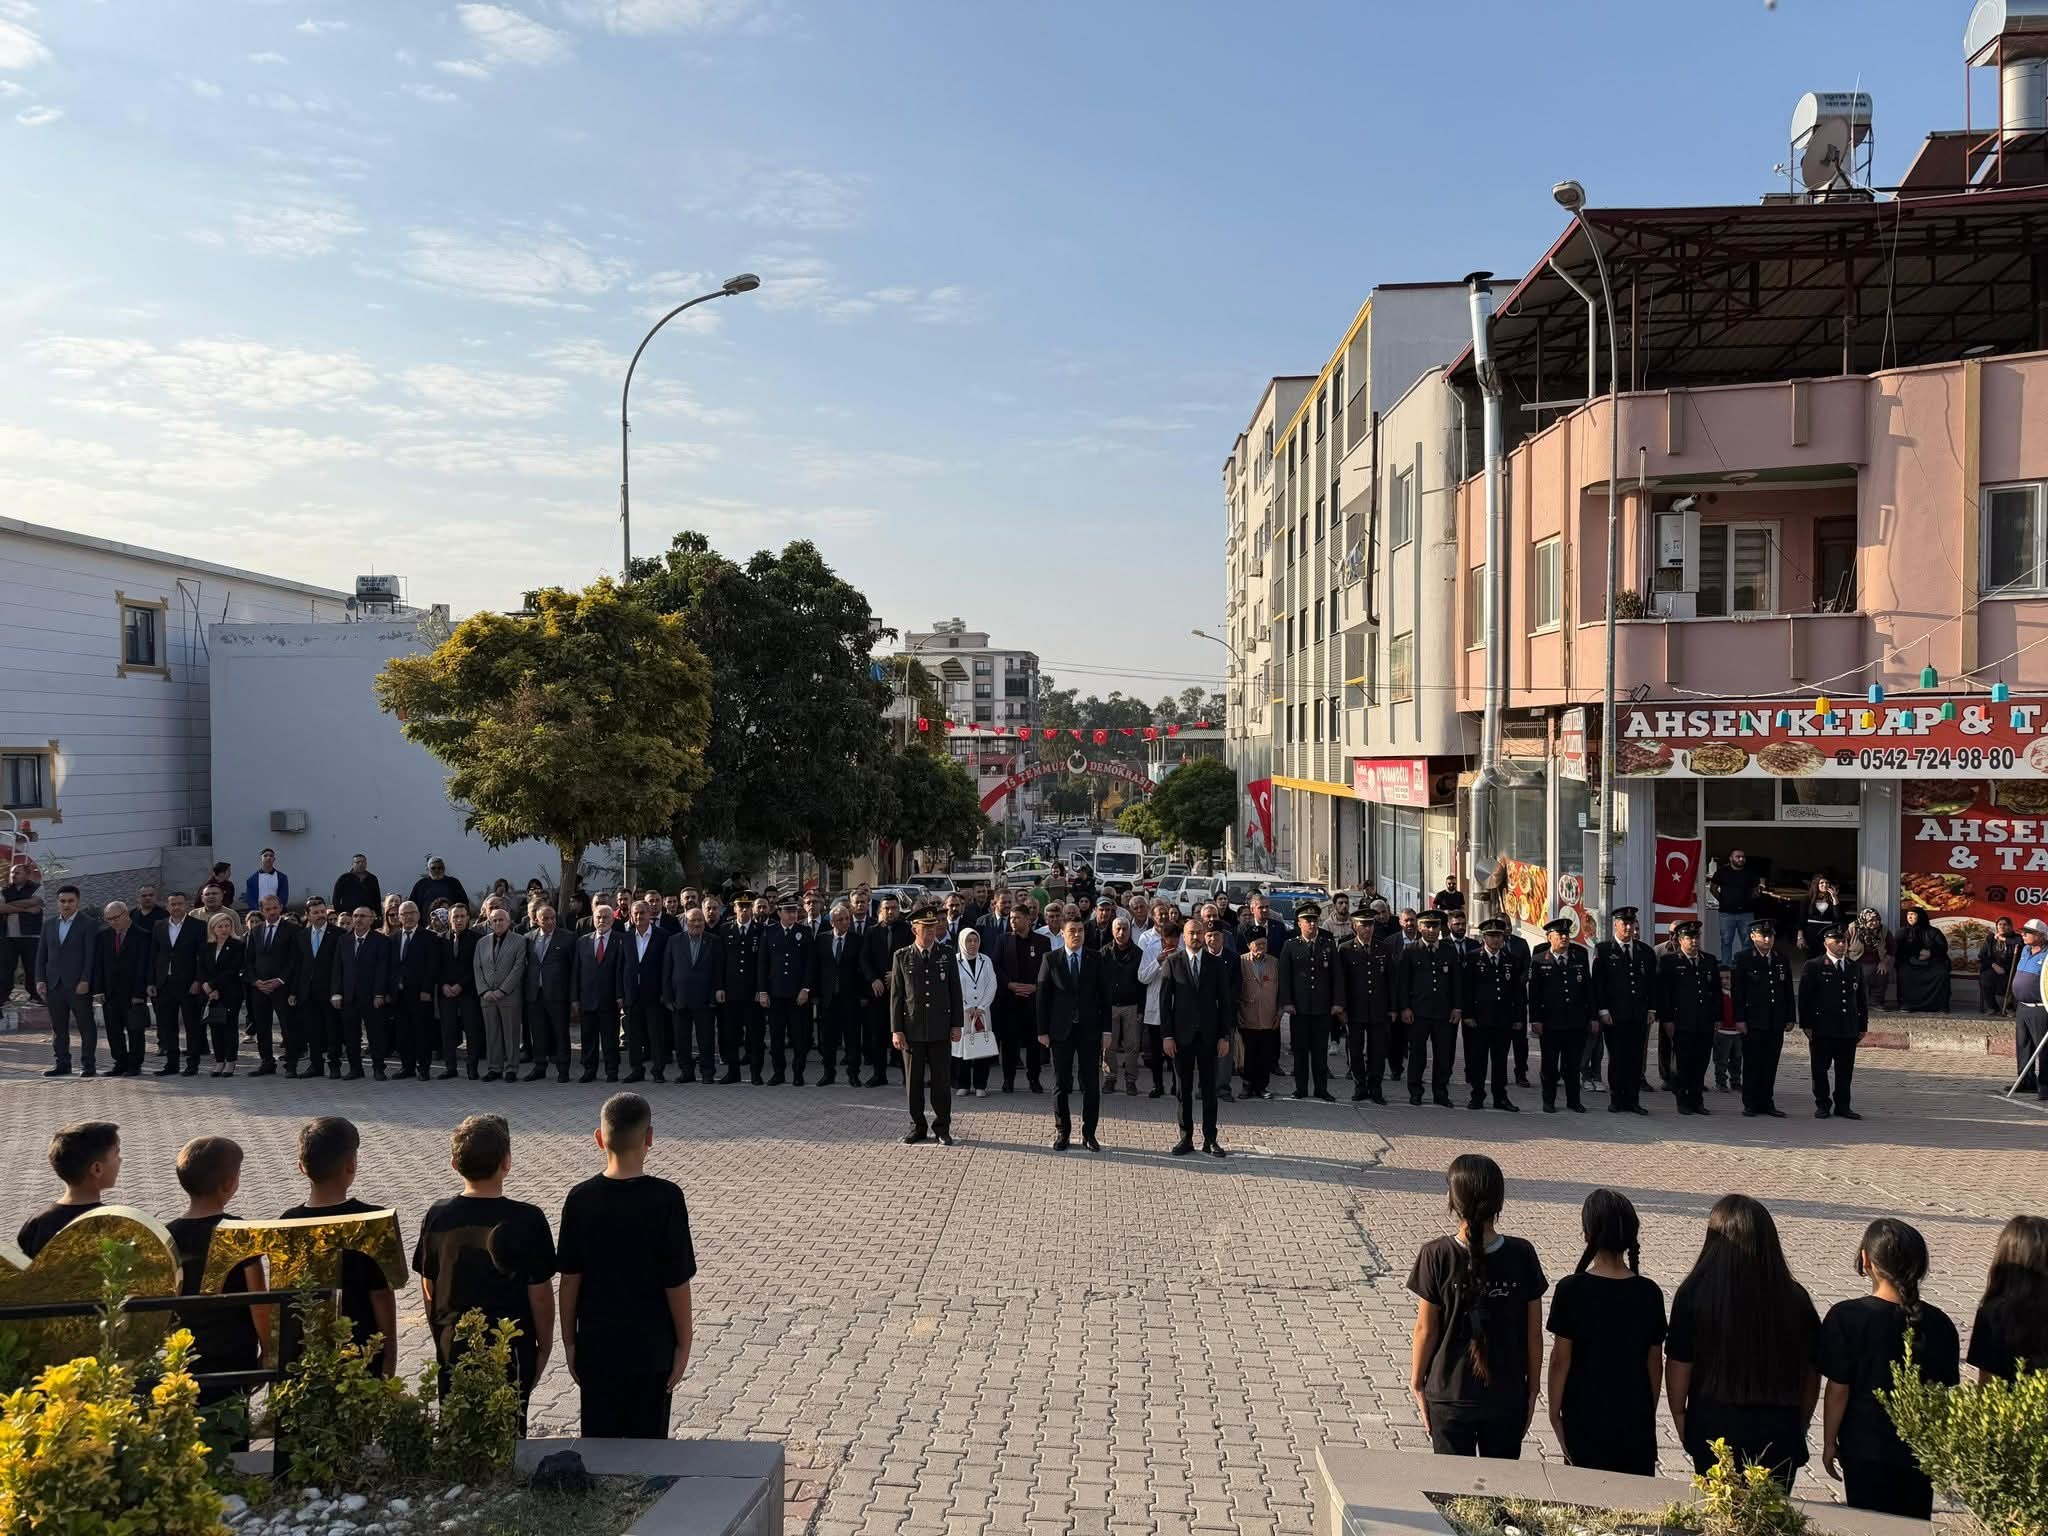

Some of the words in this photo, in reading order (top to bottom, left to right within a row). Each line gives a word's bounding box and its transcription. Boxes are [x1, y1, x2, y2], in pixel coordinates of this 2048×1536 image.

[1623, 709, 1772, 738] AHSEN
[1787, 706, 1942, 737] KEBAP
[1959, 705, 1994, 735] &
[2009, 704, 2048, 735] T
[1860, 748, 1908, 770] 0542
[1914, 748, 1951, 770] 724
[1957, 748, 1982, 770] 98
[1989, 747, 2014, 770] 80
[1018, 761, 1067, 783] TEMMUZ
[1948, 846, 1980, 870] &
